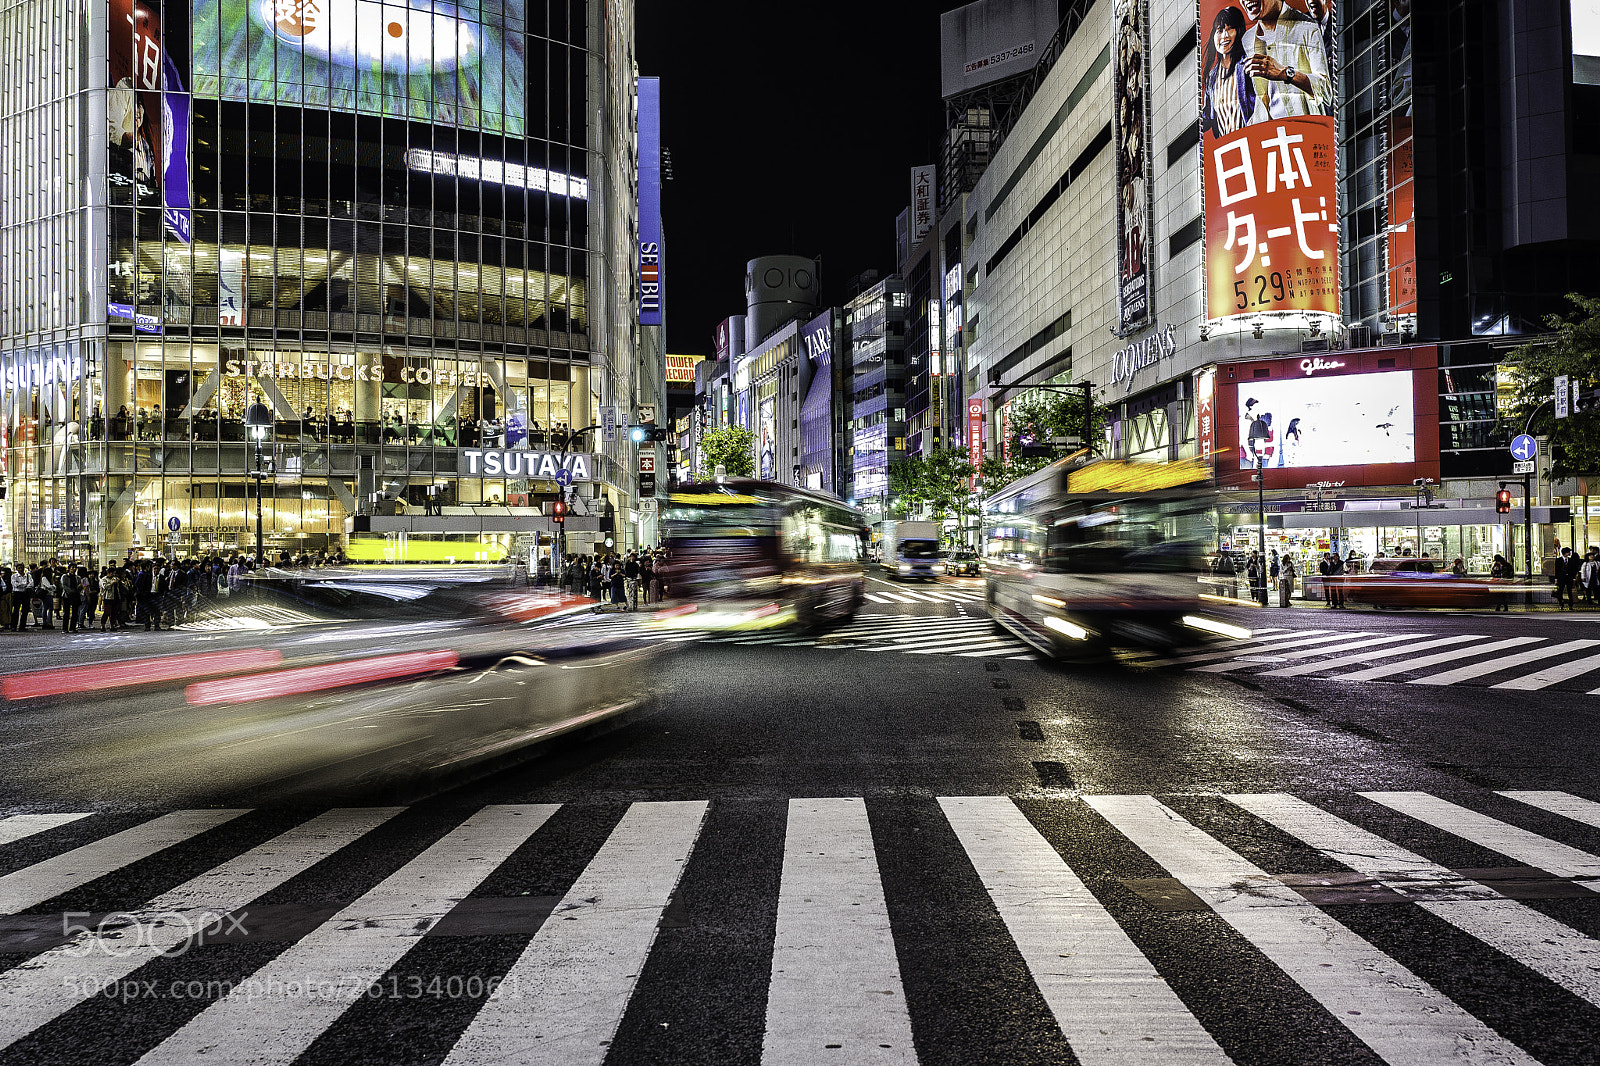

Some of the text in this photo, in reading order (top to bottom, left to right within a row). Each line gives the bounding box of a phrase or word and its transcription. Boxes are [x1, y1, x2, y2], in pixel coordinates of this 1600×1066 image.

[990, 43, 1034, 65] 5337-2468
[1213, 126, 1312, 207] 日本
[916, 171, 930, 226] 大和証券
[641, 242, 659, 309] SEIBU
[1233, 269, 1295, 310] 5.29 SUN
[804, 324, 831, 360] ZARA
[225, 359, 489, 388] STARBUCKS COFFEE
[666, 356, 694, 368] TOWER
[1300, 357, 1345, 376] Glico
[465, 450, 588, 478] TSUTAYA
[641, 458, 653, 470] 本
